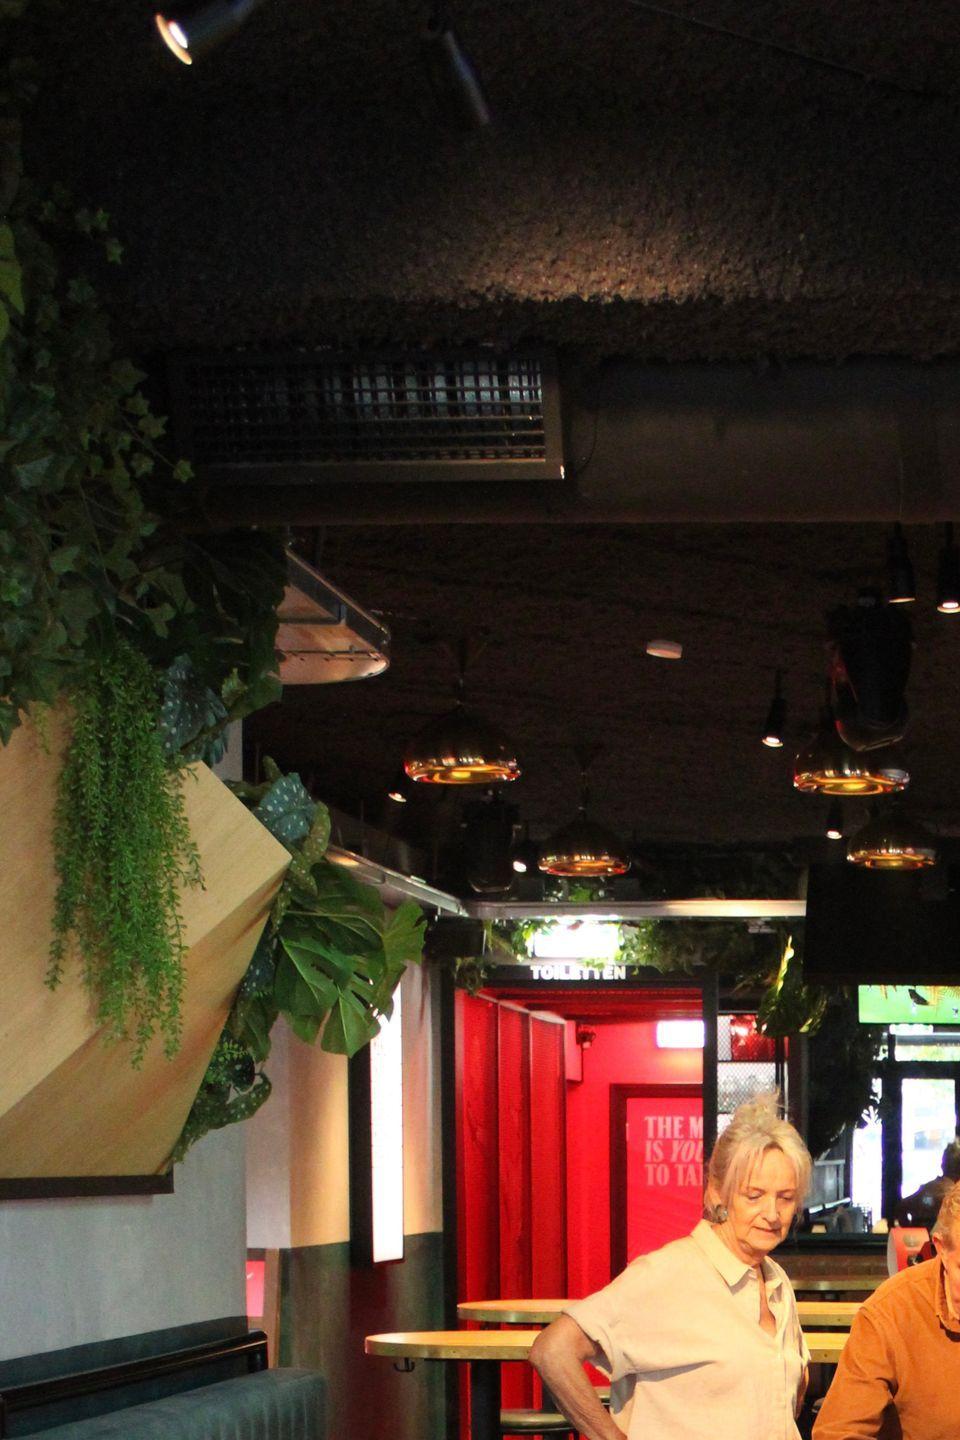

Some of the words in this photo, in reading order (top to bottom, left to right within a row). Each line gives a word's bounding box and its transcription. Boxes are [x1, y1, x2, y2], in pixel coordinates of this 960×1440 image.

[530, 965, 626, 980] TOILETTEN
[644, 1115, 684, 1139] THE
[645, 1140, 664, 1162] IS
[645, 1164, 670, 1186] TO
[674, 1164, 703, 1186] TA
